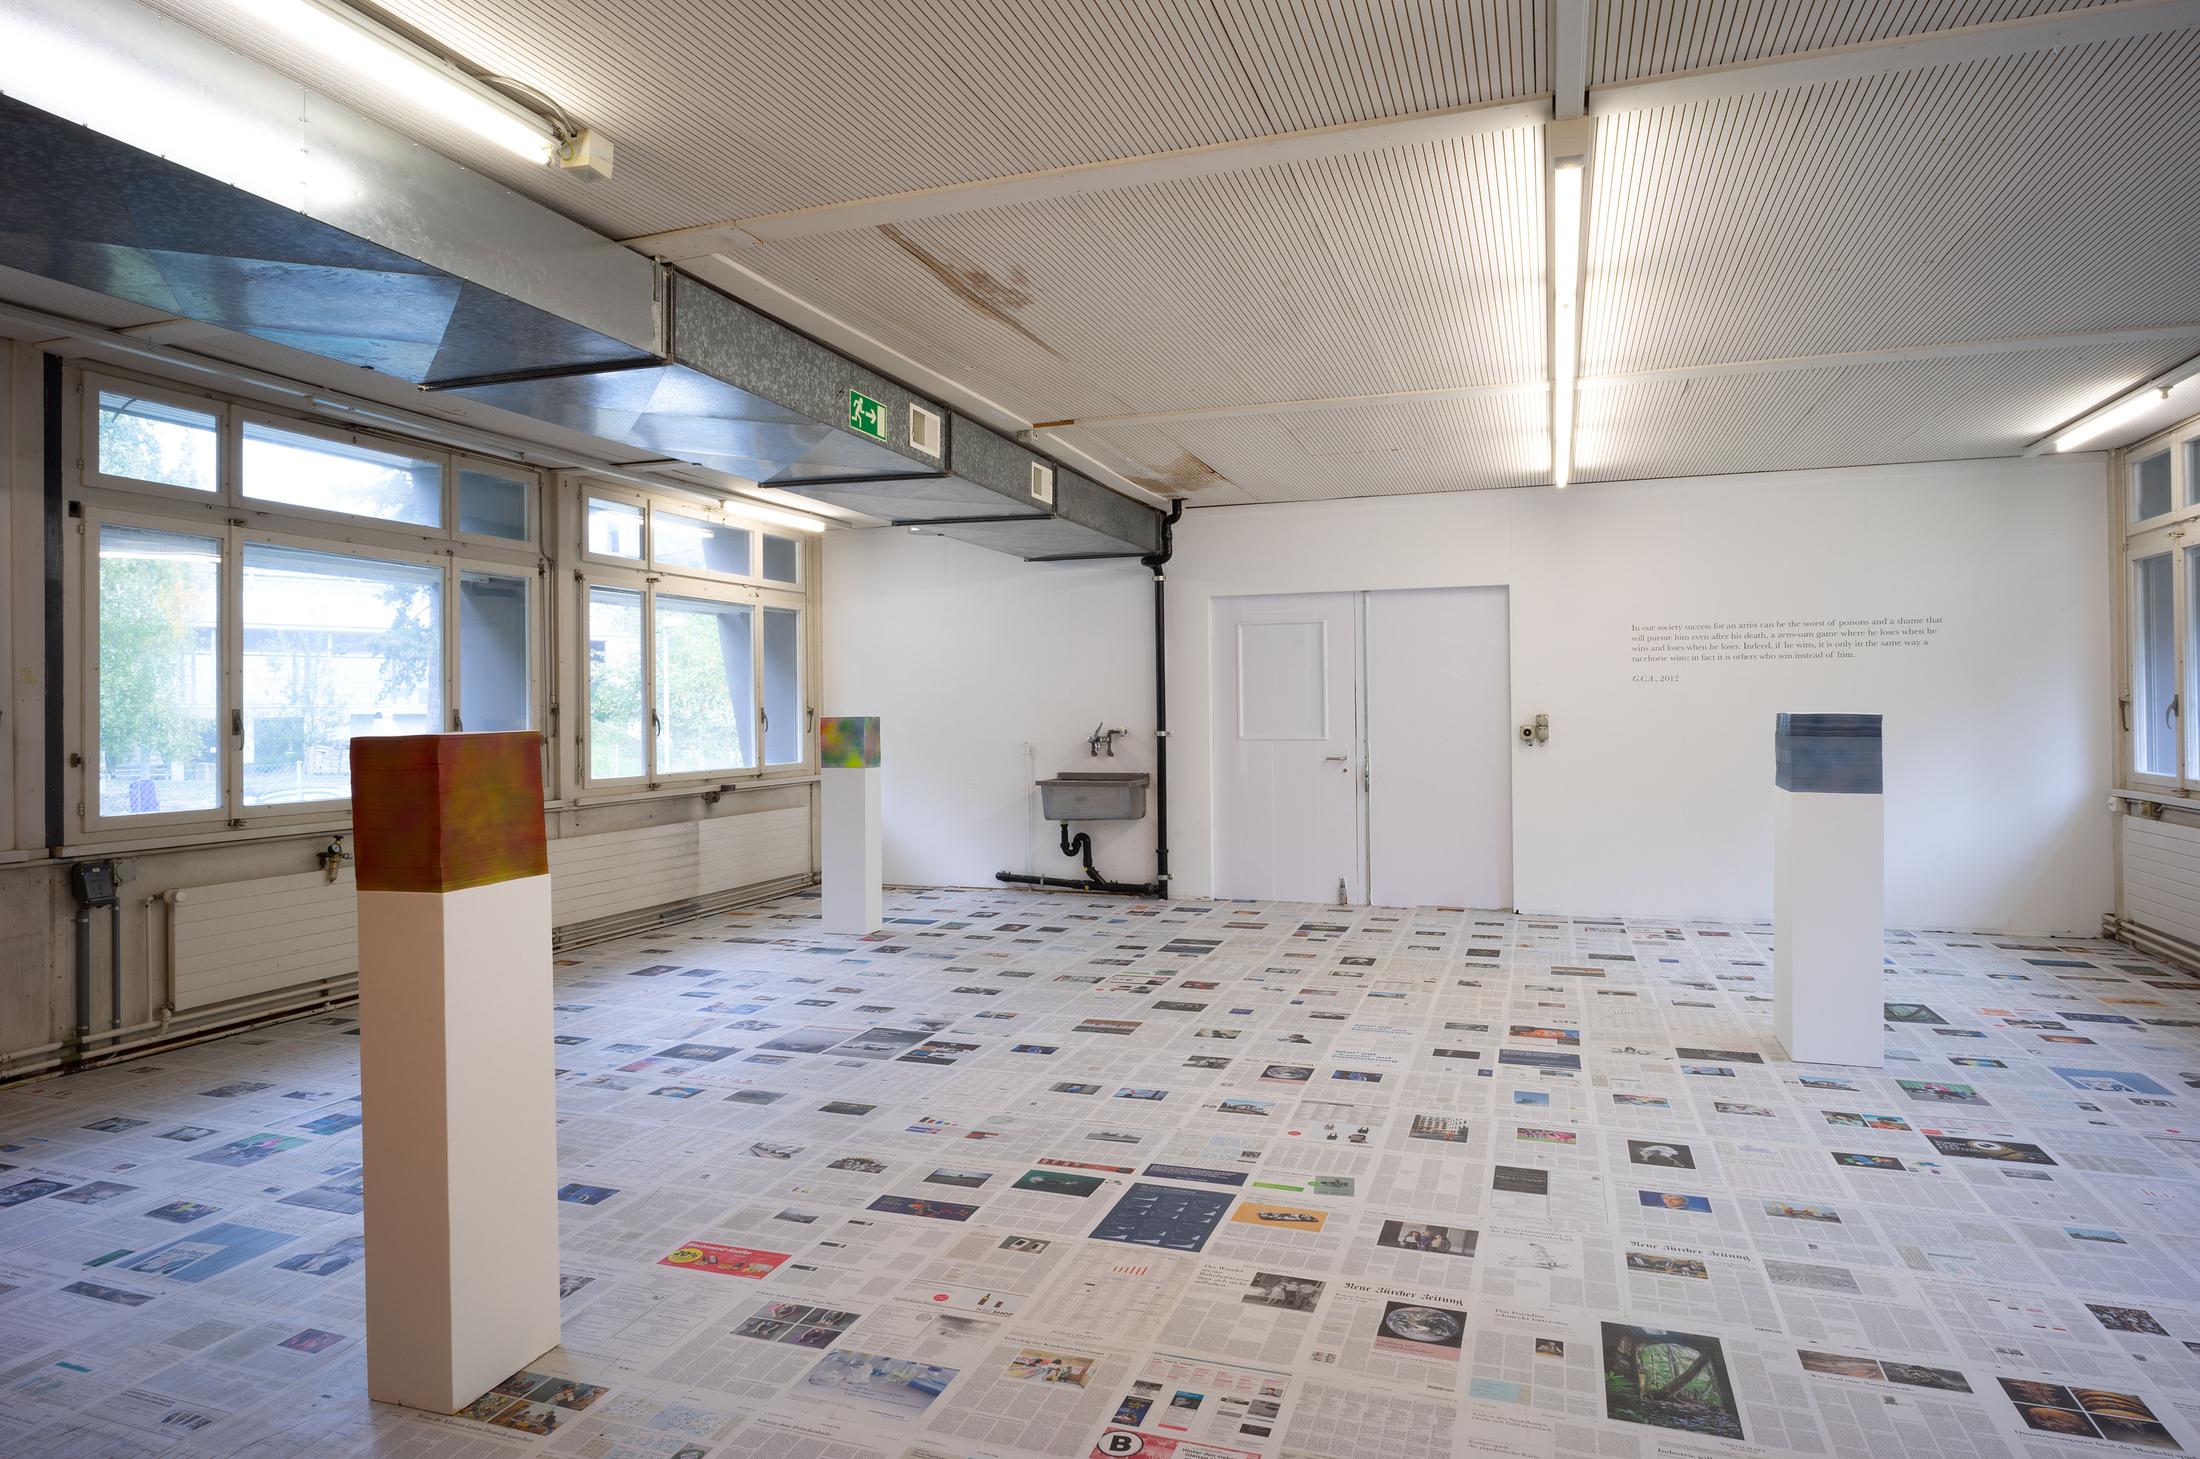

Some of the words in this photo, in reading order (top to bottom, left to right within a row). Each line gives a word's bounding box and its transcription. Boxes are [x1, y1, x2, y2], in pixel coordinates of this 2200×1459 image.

[1631, 624, 1640, 632] In
[1656, 624, 1682, 633] society
[1713, 622, 1725, 630] for
[1776, 620, 1787, 628] be
[1788, 620, 1801, 628] the
[1825, 619, 1835, 627] of
[1838, 619, 1869, 628] poisons
[1871, 617, 1887, 625] and
[1896, 617, 1924, 625] shame
[1925, 616, 1943, 624] that
[1631, 634, 1645, 643] will
[1646, 635, 1672, 644] pursue
[1674, 633, 1690, 641] him
[1711, 632, 1729, 640] after
[1731, 632, 1742, 640] his
[1743, 632, 1769, 640] death,
[1777, 631, 1814, 639] zero-sum
[1815, 631, 1839, 639] game
[1840, 629, 1866, 637] where
[1867, 628, 1878, 637] he
[1880, 628, 1899, 637] loses
[1902, 627, 1925, 635] when
[1926, 627, 1937, 635] he
[1631, 645, 1649, 653] wins
[1650, 644, 1665, 652] and
[1666, 643, 1685, 652] loses
[1686, 643, 1707, 651] when
[1709, 642, 1719, 650] he
[1720, 642, 1741, 650] loses.
[1743, 641, 1773, 650] Indeed,
[1775, 641, 1783, 649] if
[1784, 641, 1794, 649] he
[1795, 641, 1817, 649] wins,
[1818, 640, 1824, 648] it
[1826, 640, 1833, 648] is
[1834, 640, 1853, 649] only
[1865, 639, 1879, 647] the
[1904, 640, 1921, 648] way
[1632, 654, 1668, 663] racehorse
[1717, 653, 1723, 661] it
[1725, 653, 1732, 661] is
[1732, 653, 1757, 661] others
[1758, 652, 1776, 660] who
[1777, 652, 1793, 660] win
[1794, 651, 1823, 659] instead
[1825, 651, 1835, 659] of
[1837, 650, 1856, 659] him.
[1659, 674, 1679, 682] 2012
[1344, 1281, 1372, 1292] Neue
[1420, 1293, 1464, 1307] Zeitung
[1109, 1435, 1133, 1452] B
